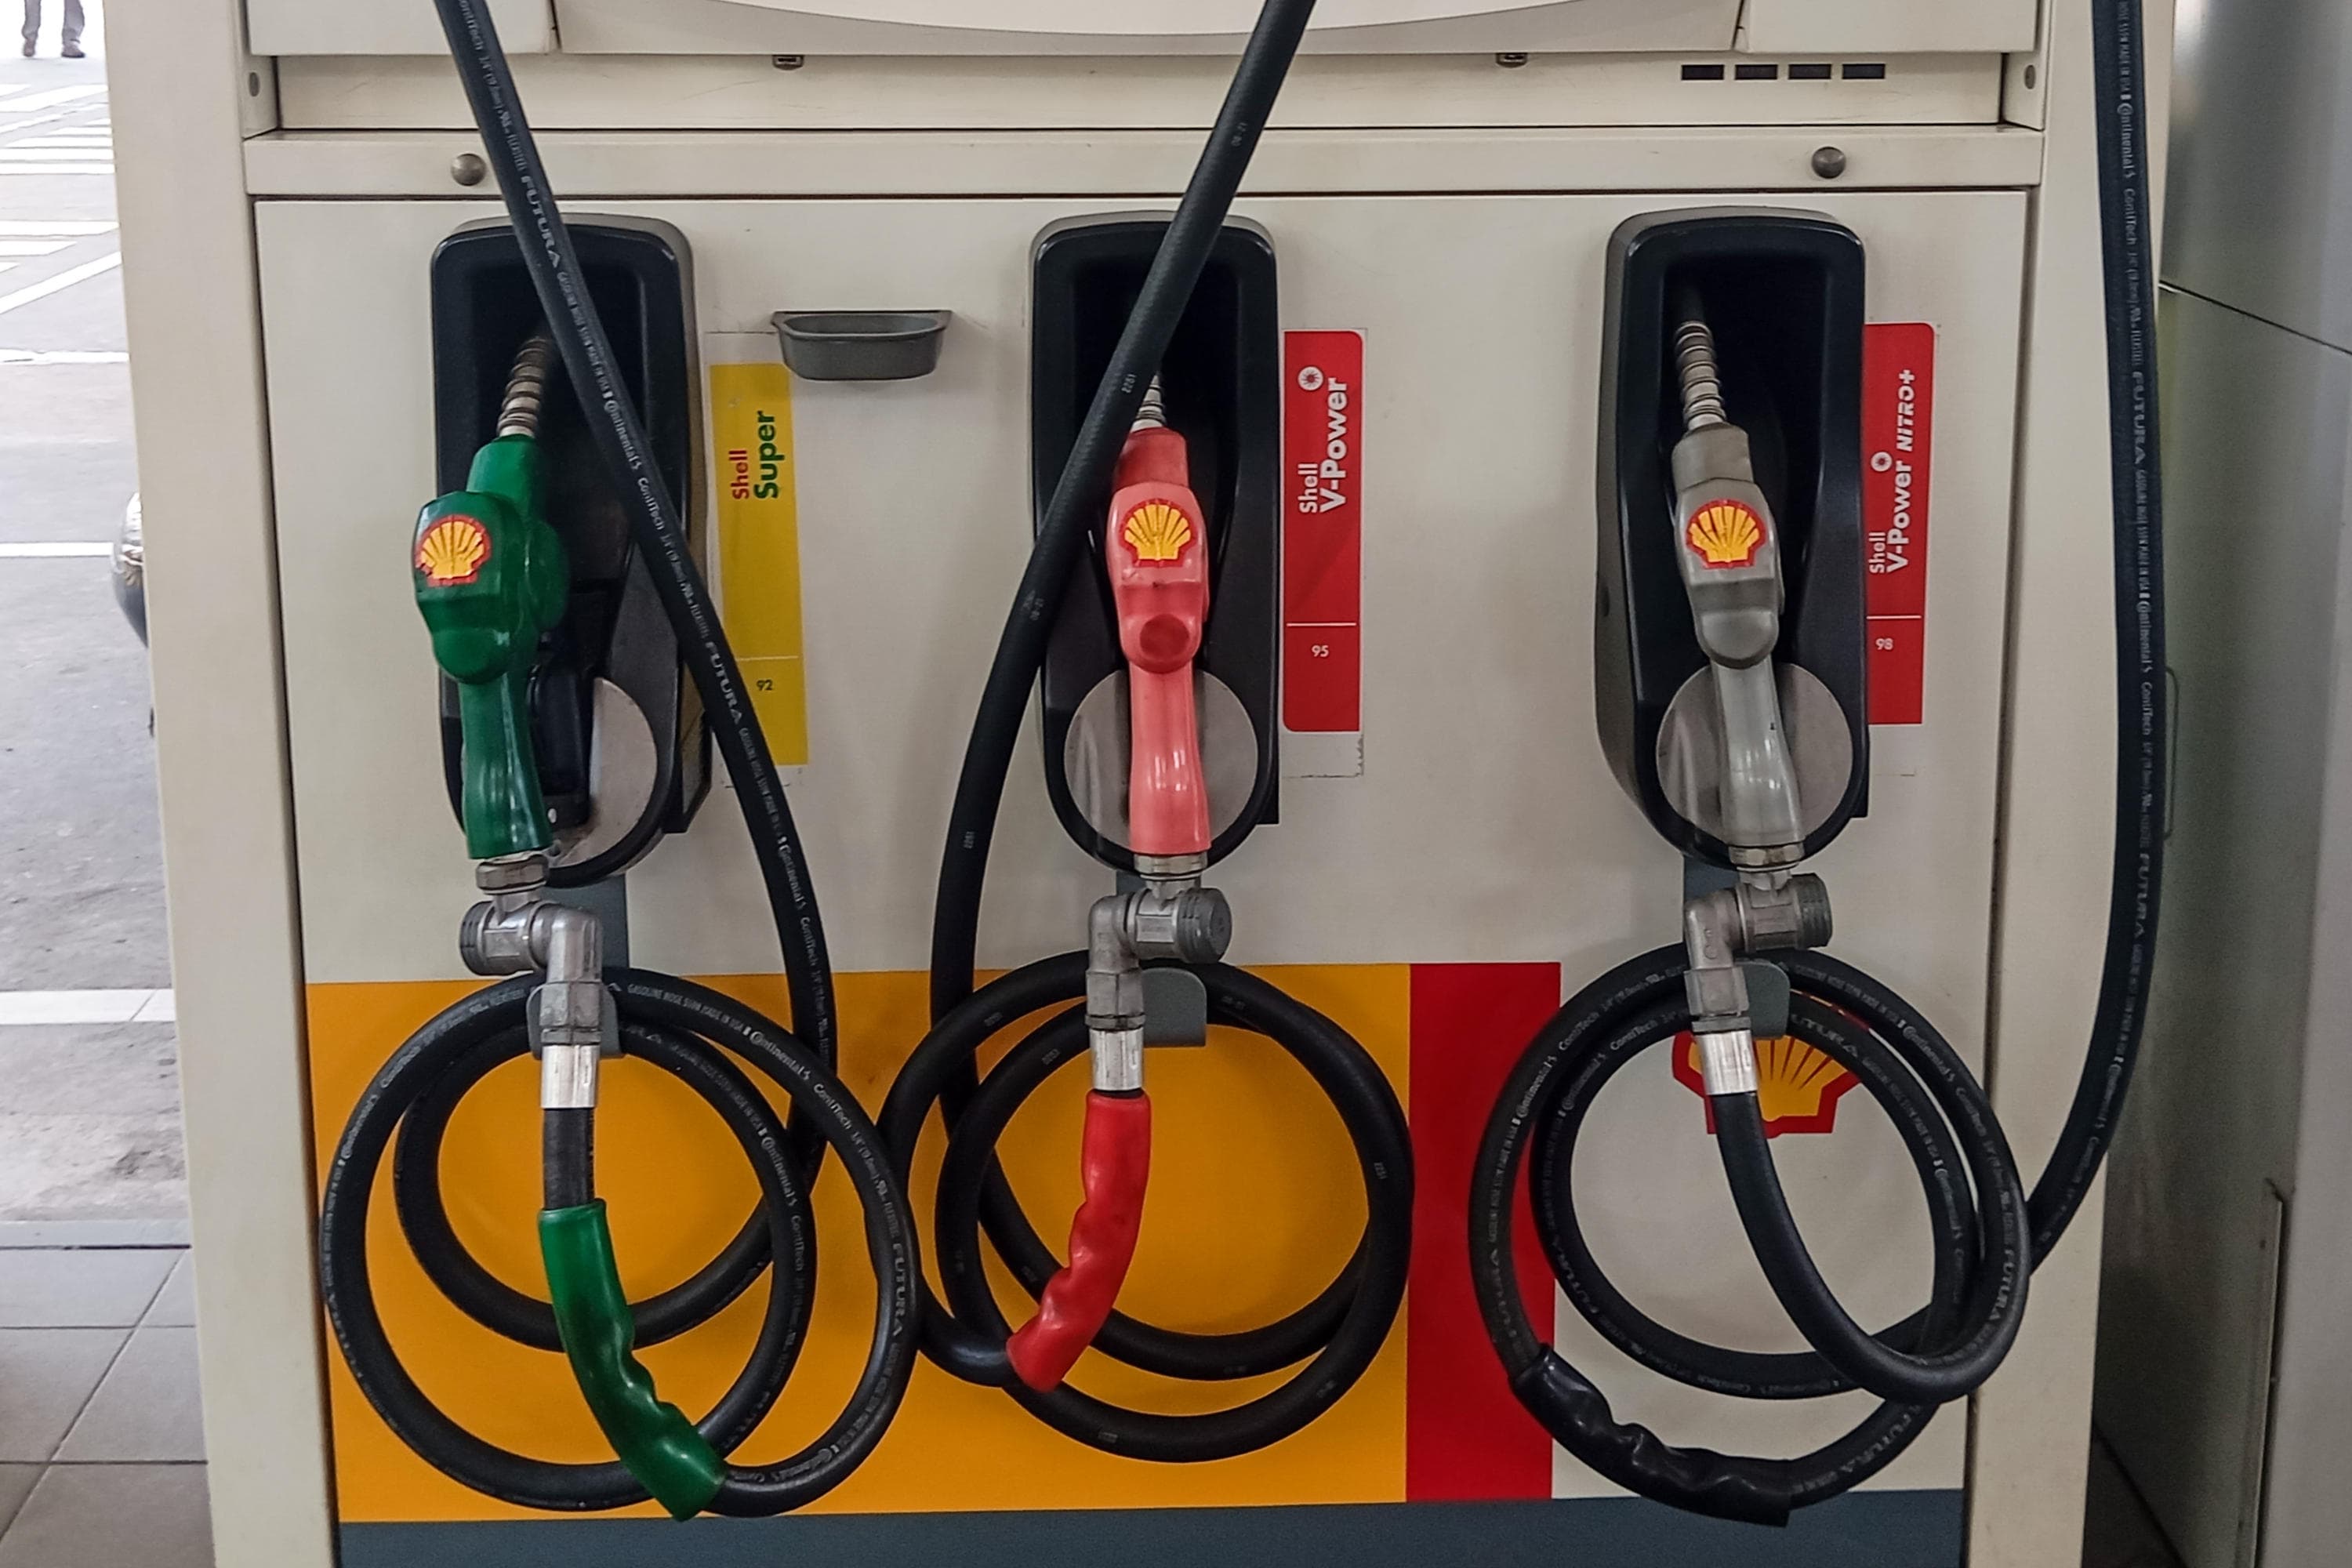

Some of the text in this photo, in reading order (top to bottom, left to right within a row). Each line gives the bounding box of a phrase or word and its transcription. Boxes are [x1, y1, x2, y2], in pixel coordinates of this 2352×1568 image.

[2118, 102, 2135, 169] Continental
[2124, 188, 2137, 245] ContiTech
[1319, 377, 1347, 512] V-Power
[2132, 371, 2146, 464] FUTURA
[459, 0, 484, 50] ontiTech
[521, 176, 561, 268] FUTURA
[604, 400, 639, 462] Continental
[637, 477, 664, 530] ContiTech
[705, 641, 742, 724] FUTURA
[800, 916, 818, 966] ContiTech
[728, 449, 750, 499] Shell
[753, 410, 785, 499] Super
[1886, 369, 1915, 572] V-Power NITRO+
[1298, 463, 1318, 513] Shell
[1868, 532, 1886, 573] Shell
[1312, 644, 1329, 657] 95
[1875, 637, 1893, 650] 98
[2138, 600, 2152, 663] Continental
[757, 679, 773, 691] 92
[2141, 681, 2153, 735] ContiTech
[2134, 853, 2150, 937] FUTURA
[1792, 1014, 1858, 1058] UTURA
[750, 1031, 806, 1075] Continental
[813, 1083, 851, 1130] ContiTech
[892, 1243, 906, 1336] FUTURA
[760, 1136, 795, 1198] Continental
[1989, 1249, 2015, 1320] FUTURA
